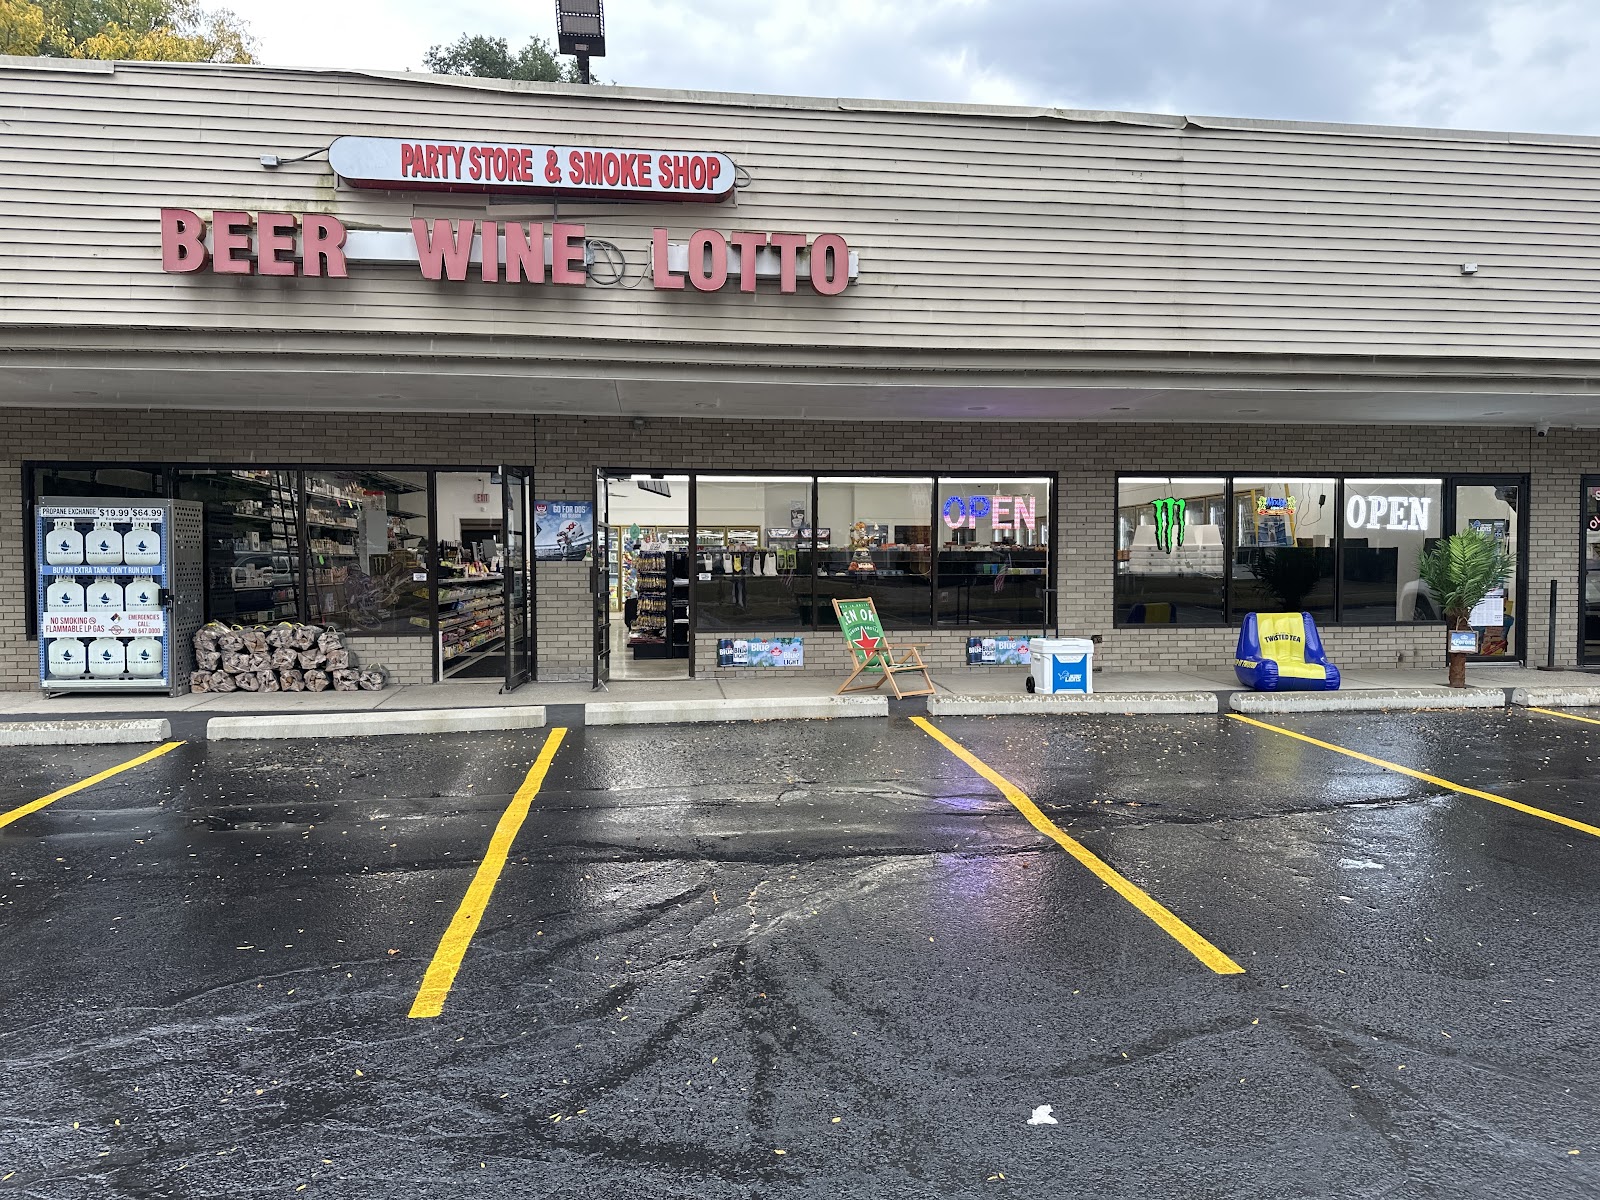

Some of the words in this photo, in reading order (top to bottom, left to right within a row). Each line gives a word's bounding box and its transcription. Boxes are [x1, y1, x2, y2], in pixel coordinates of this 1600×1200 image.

[401, 143, 465, 179] PARTY
[469, 146, 533, 182] STORE
[544, 149, 563, 183] &
[569, 150, 652, 187] SMOKE
[658, 155, 721, 190] SHOP
[161, 208, 348, 278] BEER
[410, 217, 587, 285] WINE
[653, 227, 850, 296] LOTTO
[42, 507, 67, 515] PROPANE
[68, 508, 97, 516] EXCHANGE
[99, 508, 129, 517] $19.99
[132, 508, 162, 517] $64.99
[562, 505, 573, 513] FOR
[943, 495, 1036, 530] OPEN
[1346, 494, 1432, 531] OPEN
[52, 566, 64, 574] BUY
[65, 566, 73, 574] AN
[74, 566, 92, 574] EXTRA
[45, 625, 83, 633] FLAMMABLE
[84, 625, 92, 633] LP
[93, 625, 105, 633] GAS
[1264, 633, 1289, 643] TWISTED
[1289, 634, 1301, 643] TEA
[751, 642, 770, 652] Blue
[998, 641, 1017, 650] Blue
[720, 647, 734, 656] Blue
[783, 651, 800, 659] Blue
